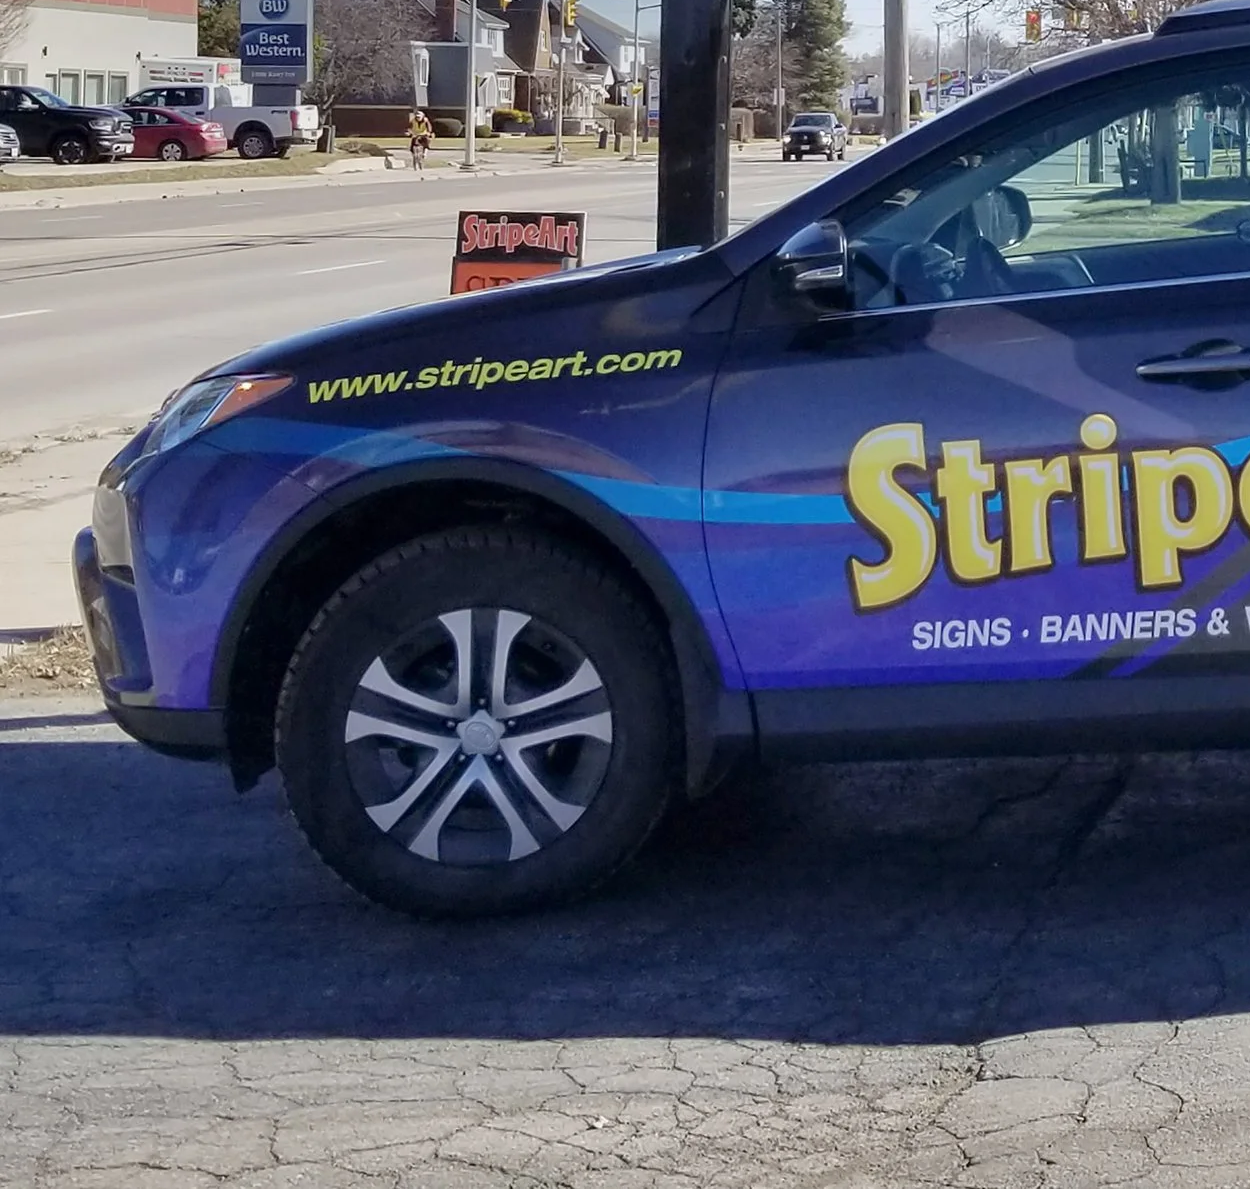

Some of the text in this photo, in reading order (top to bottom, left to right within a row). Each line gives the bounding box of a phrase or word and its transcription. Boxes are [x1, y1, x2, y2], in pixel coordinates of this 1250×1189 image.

[261, 0, 287, 13] BW
[259, 32, 290, 45] Best
[461, 214, 578, 256] StripeArt
[308, 348, 684, 404] www.stripeart.com
[911, 618, 1012, 650] SIGNS
[1040, 608, 1197, 644] BANNERS
[1207, 608, 1231, 637] &
